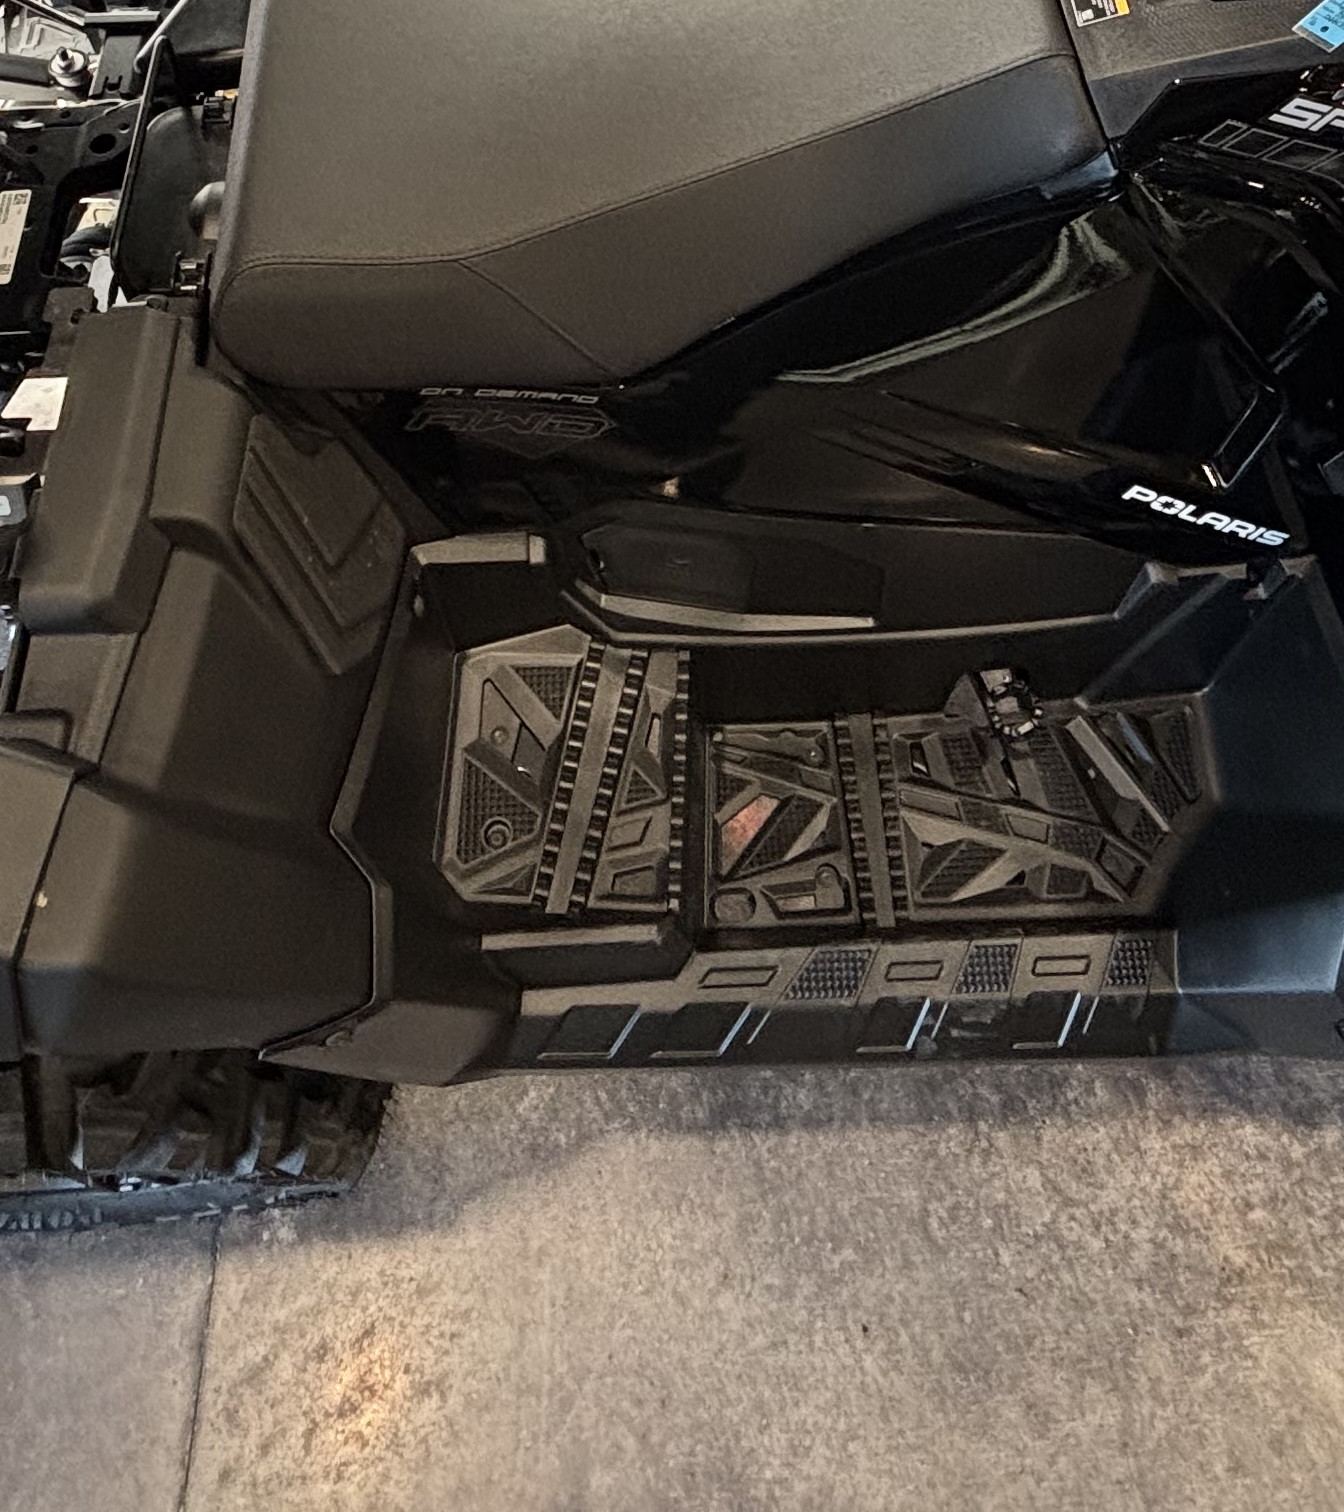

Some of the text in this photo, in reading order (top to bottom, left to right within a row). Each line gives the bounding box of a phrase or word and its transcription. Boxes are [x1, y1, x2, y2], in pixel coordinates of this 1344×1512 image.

[420, 387, 599, 405] ON DEMAND
[406, 406, 613, 440] AWD
[1121, 484, 1291, 547] POLARIS
